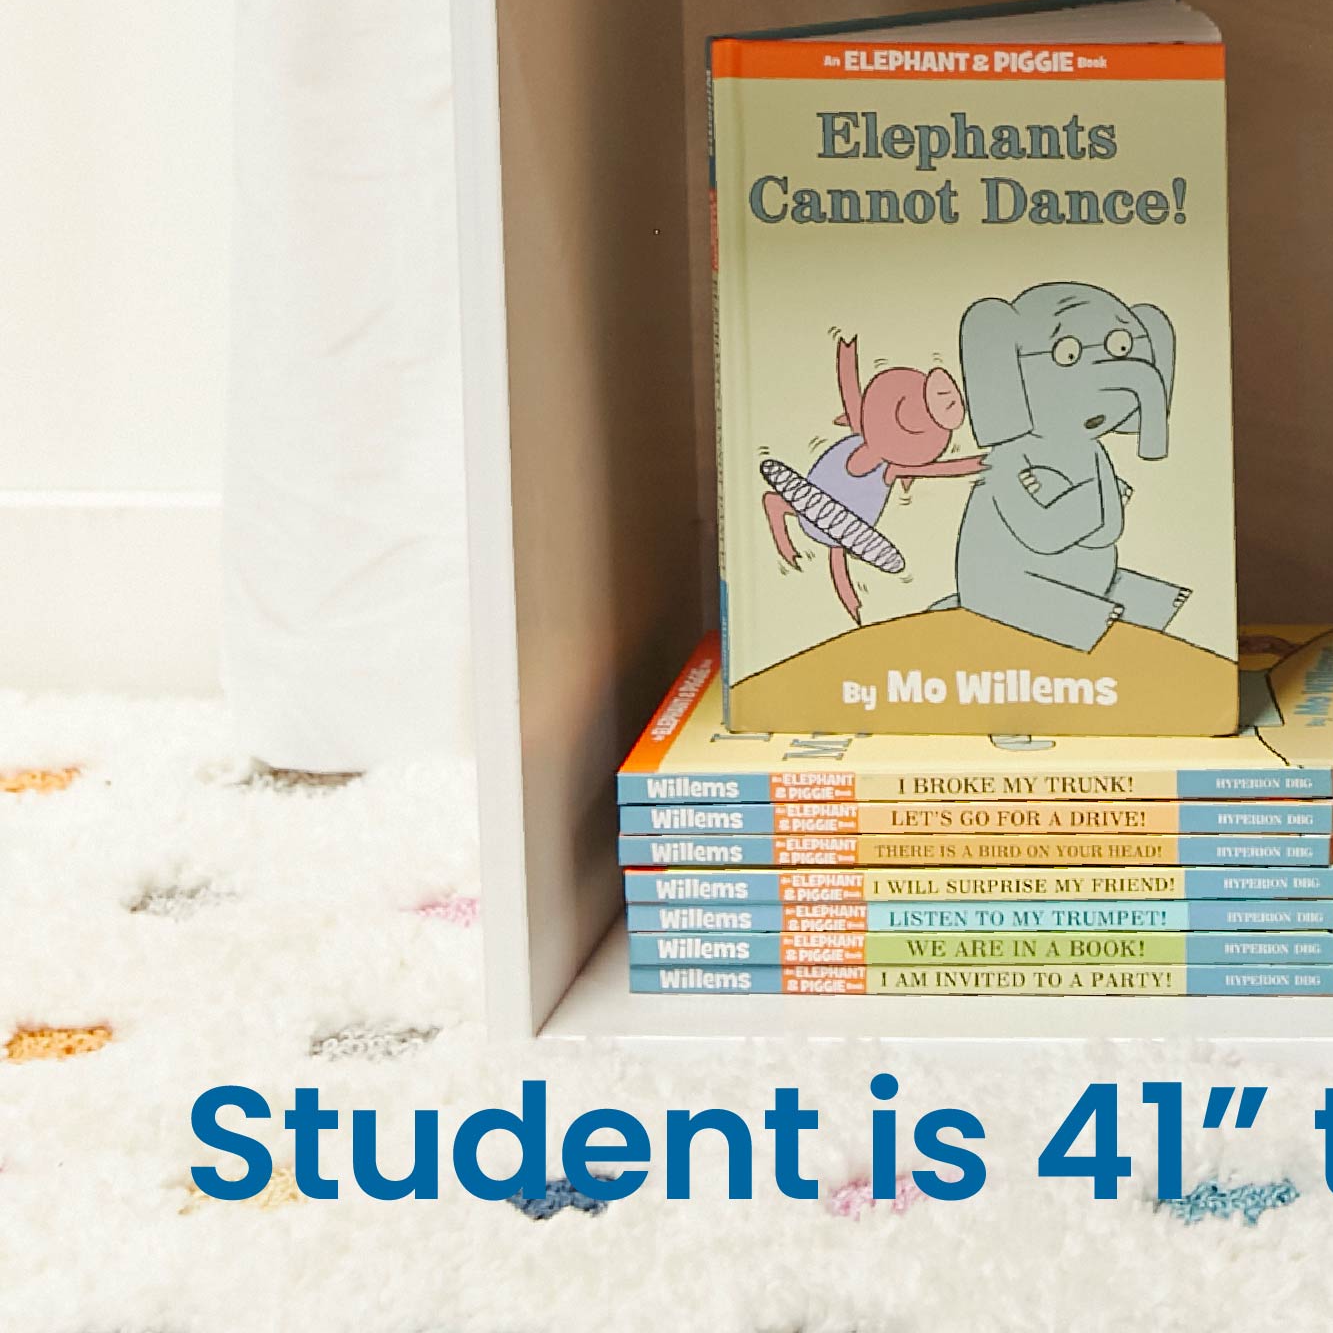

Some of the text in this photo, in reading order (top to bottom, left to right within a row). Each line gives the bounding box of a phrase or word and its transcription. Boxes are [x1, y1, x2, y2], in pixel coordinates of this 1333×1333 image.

[824, 50, 1107, 73] An ELEPHANT & PIGGIE Book
[816, 111, 1118, 171] Elephants
[748, 175, 1189, 225] Cannot Dance!
[843, 669, 1118, 710] By Mo Willems
[647, 777, 739, 798] Willems
[915, 778, 994, 795] BROKE
[1004, 777, 1036, 794] MY
[1046, 777, 1132, 794] TRUNK!
[652, 809, 743, 828] Willems
[893, 810, 1144, 828] LET'S GO FOR A DRIVE!
[656, 879, 748, 899] Willems
[888, 880, 938, 895] WILL
[947, 879, 1046, 895] SURPRISE
[1056, 879, 1082, 894] MY
[1092, 878, 1174, 894] FRIEND!
[660, 909, 751, 929] Willems
[890, 911, 1166, 927] LISTEN TO MY TRUMPET!
[658, 938, 749, 958] Willems
[908, 940, 1144, 958] WE ARE IN A BOOK!
[899, 972, 926, 988] AM
[937, 972, 1025, 988] INVITED
[1034, 973, 1062, 988] TO
[1071, 973, 1082, 988] A
[1093, 973, 1170, 988] PARTY!
